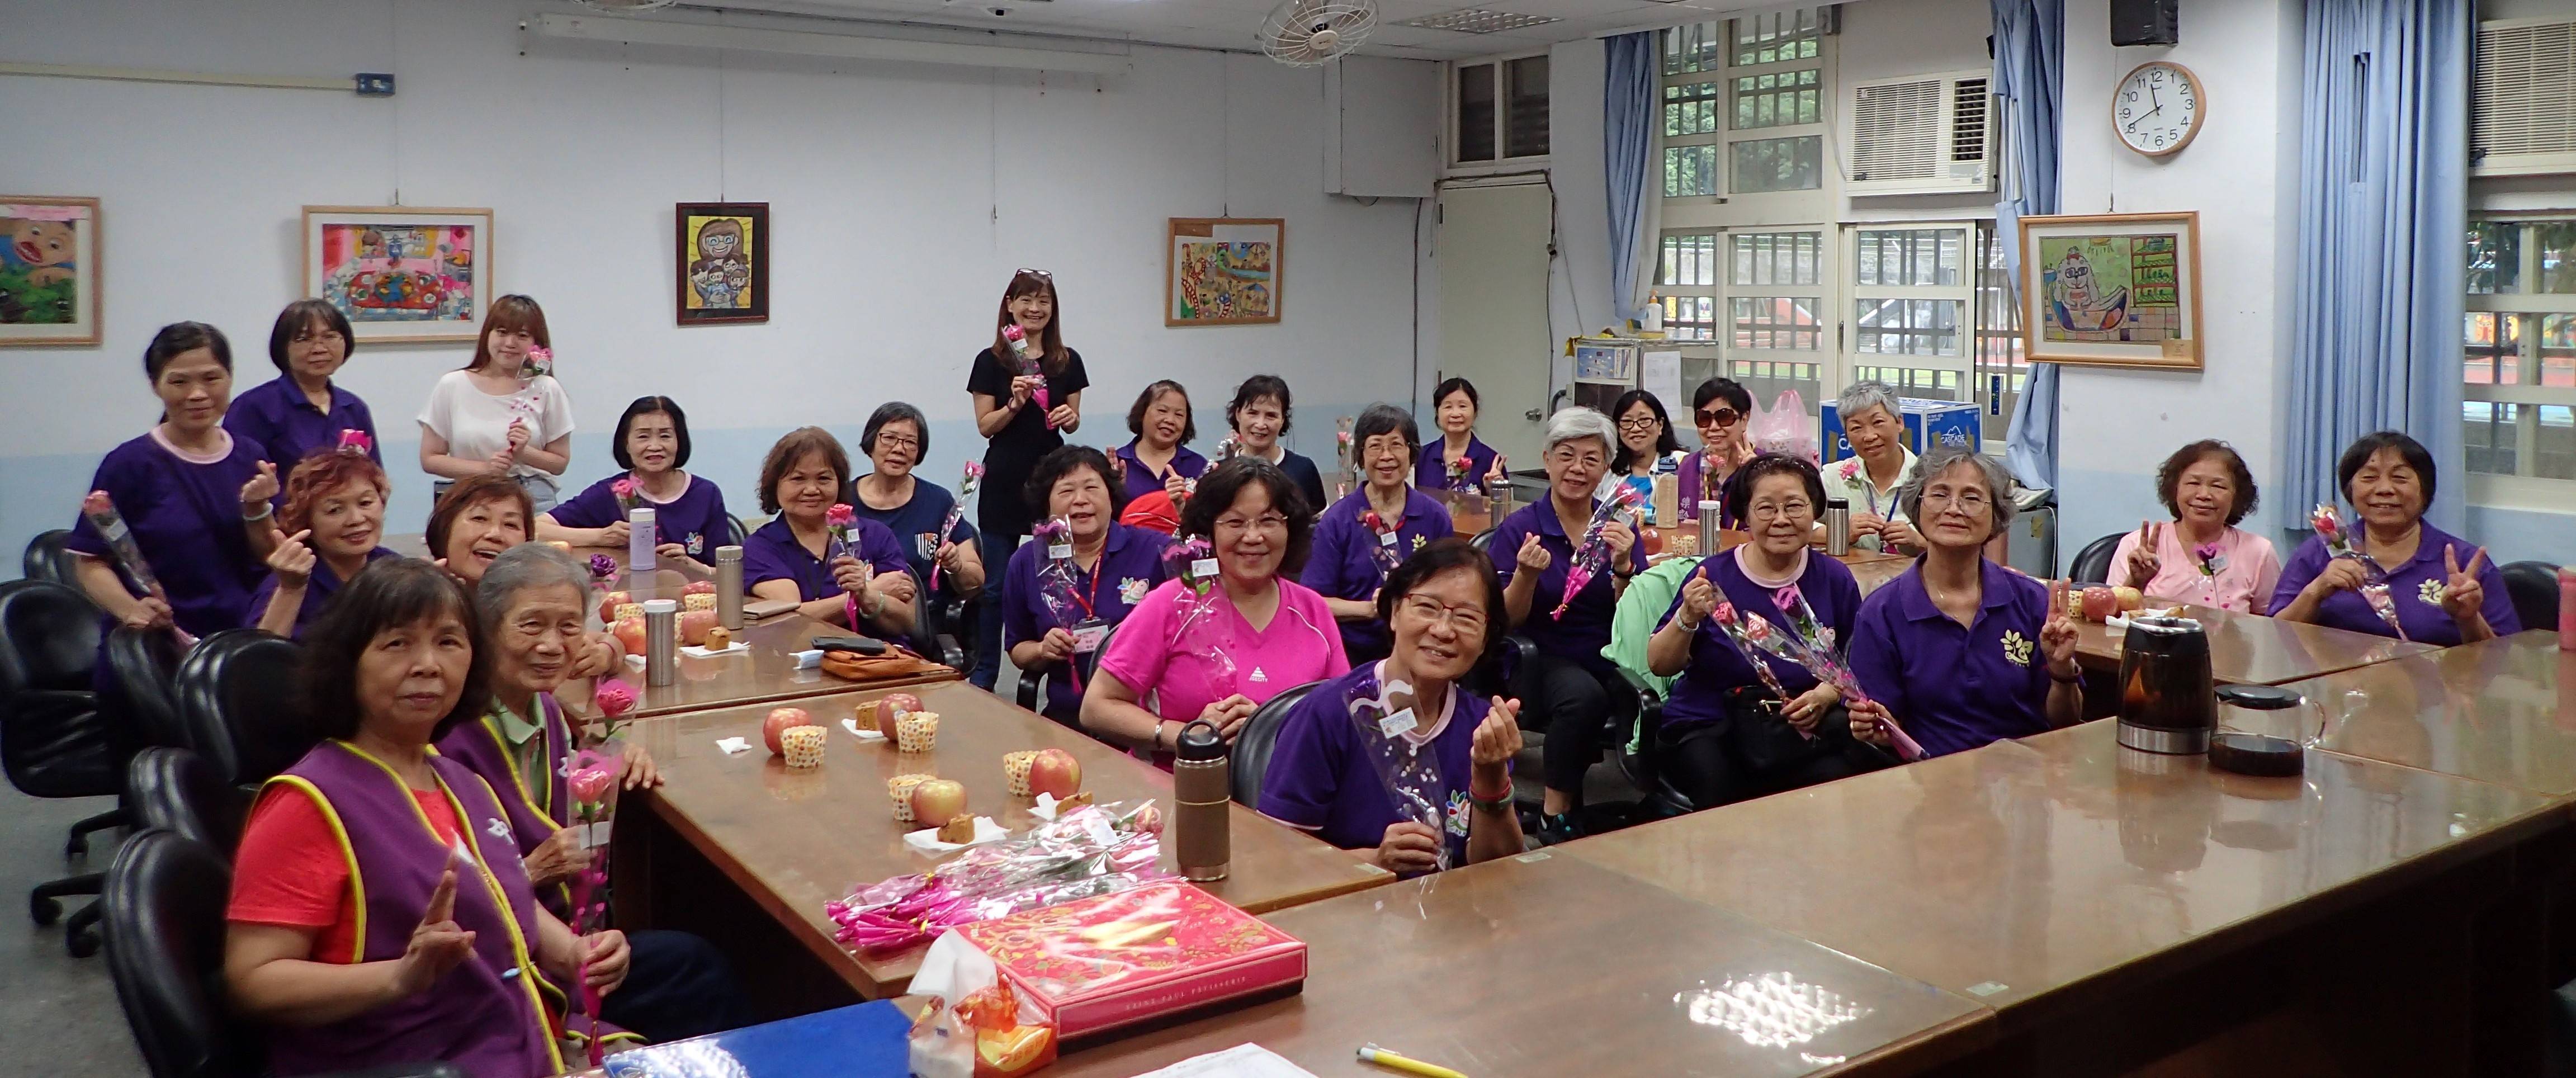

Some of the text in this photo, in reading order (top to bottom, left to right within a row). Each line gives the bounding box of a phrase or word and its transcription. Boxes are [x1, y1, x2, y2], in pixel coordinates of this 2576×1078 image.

[2150, 71, 2162, 82] 12
[2170, 74, 2175, 83] 1
[2137, 79, 2145, 88] 11
[2180, 84, 2188, 94] 2
[2126, 92, 2138, 102] 10
[2185, 99, 2193, 110] 3
[2123, 108, 2130, 118] 9
[2181, 116, 2188, 126] 4
[2128, 124, 2136, 133] 8
[2141, 133, 2148, 143] 7
[2169, 129, 2177, 139] 5
[2155, 136, 2163, 146] 6
[1941, 434, 1965, 443] CASCADE
[1162, 991, 1185, 1002] PAUL
